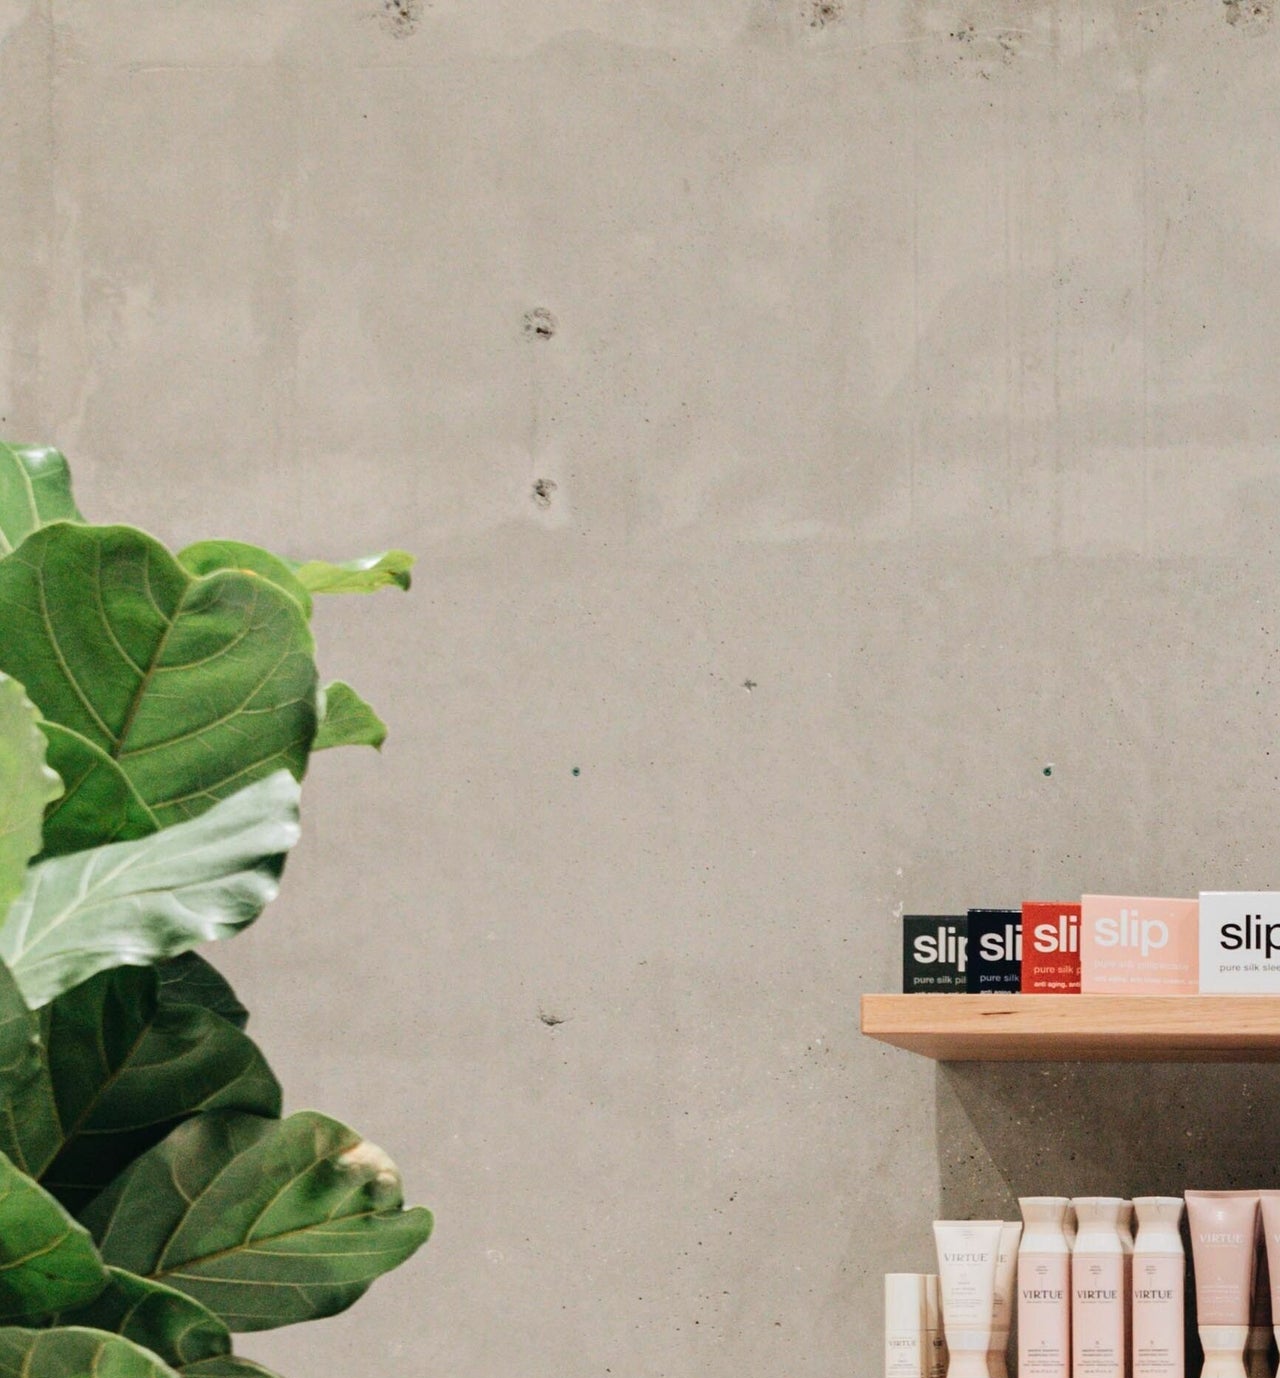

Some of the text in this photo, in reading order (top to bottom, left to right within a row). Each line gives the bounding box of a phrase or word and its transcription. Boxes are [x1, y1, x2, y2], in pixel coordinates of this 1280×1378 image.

[1034, 915, 1078, 953] sli
[1094, 908, 1169, 957] slip
[980, 924, 1022, 962] sli
[1034, 965, 1074, 974] pure silk
[1219, 964, 1241, 973] pure
[1244, 963, 1260, 972] silk
[913, 976, 934, 985] pure
[936, 975, 952, 984] silk
[980, 974, 1020, 984] pure silk
[1200, 1234, 1244, 1243] VIRTUE
[944, 1252, 988, 1262] VIRTUE
[1022, 1290, 1064, 1300] VIRTUE
[1076, 1290, 1118, 1300] VIRTUE
[1134, 1290, 1174, 1300] VIRTUE
